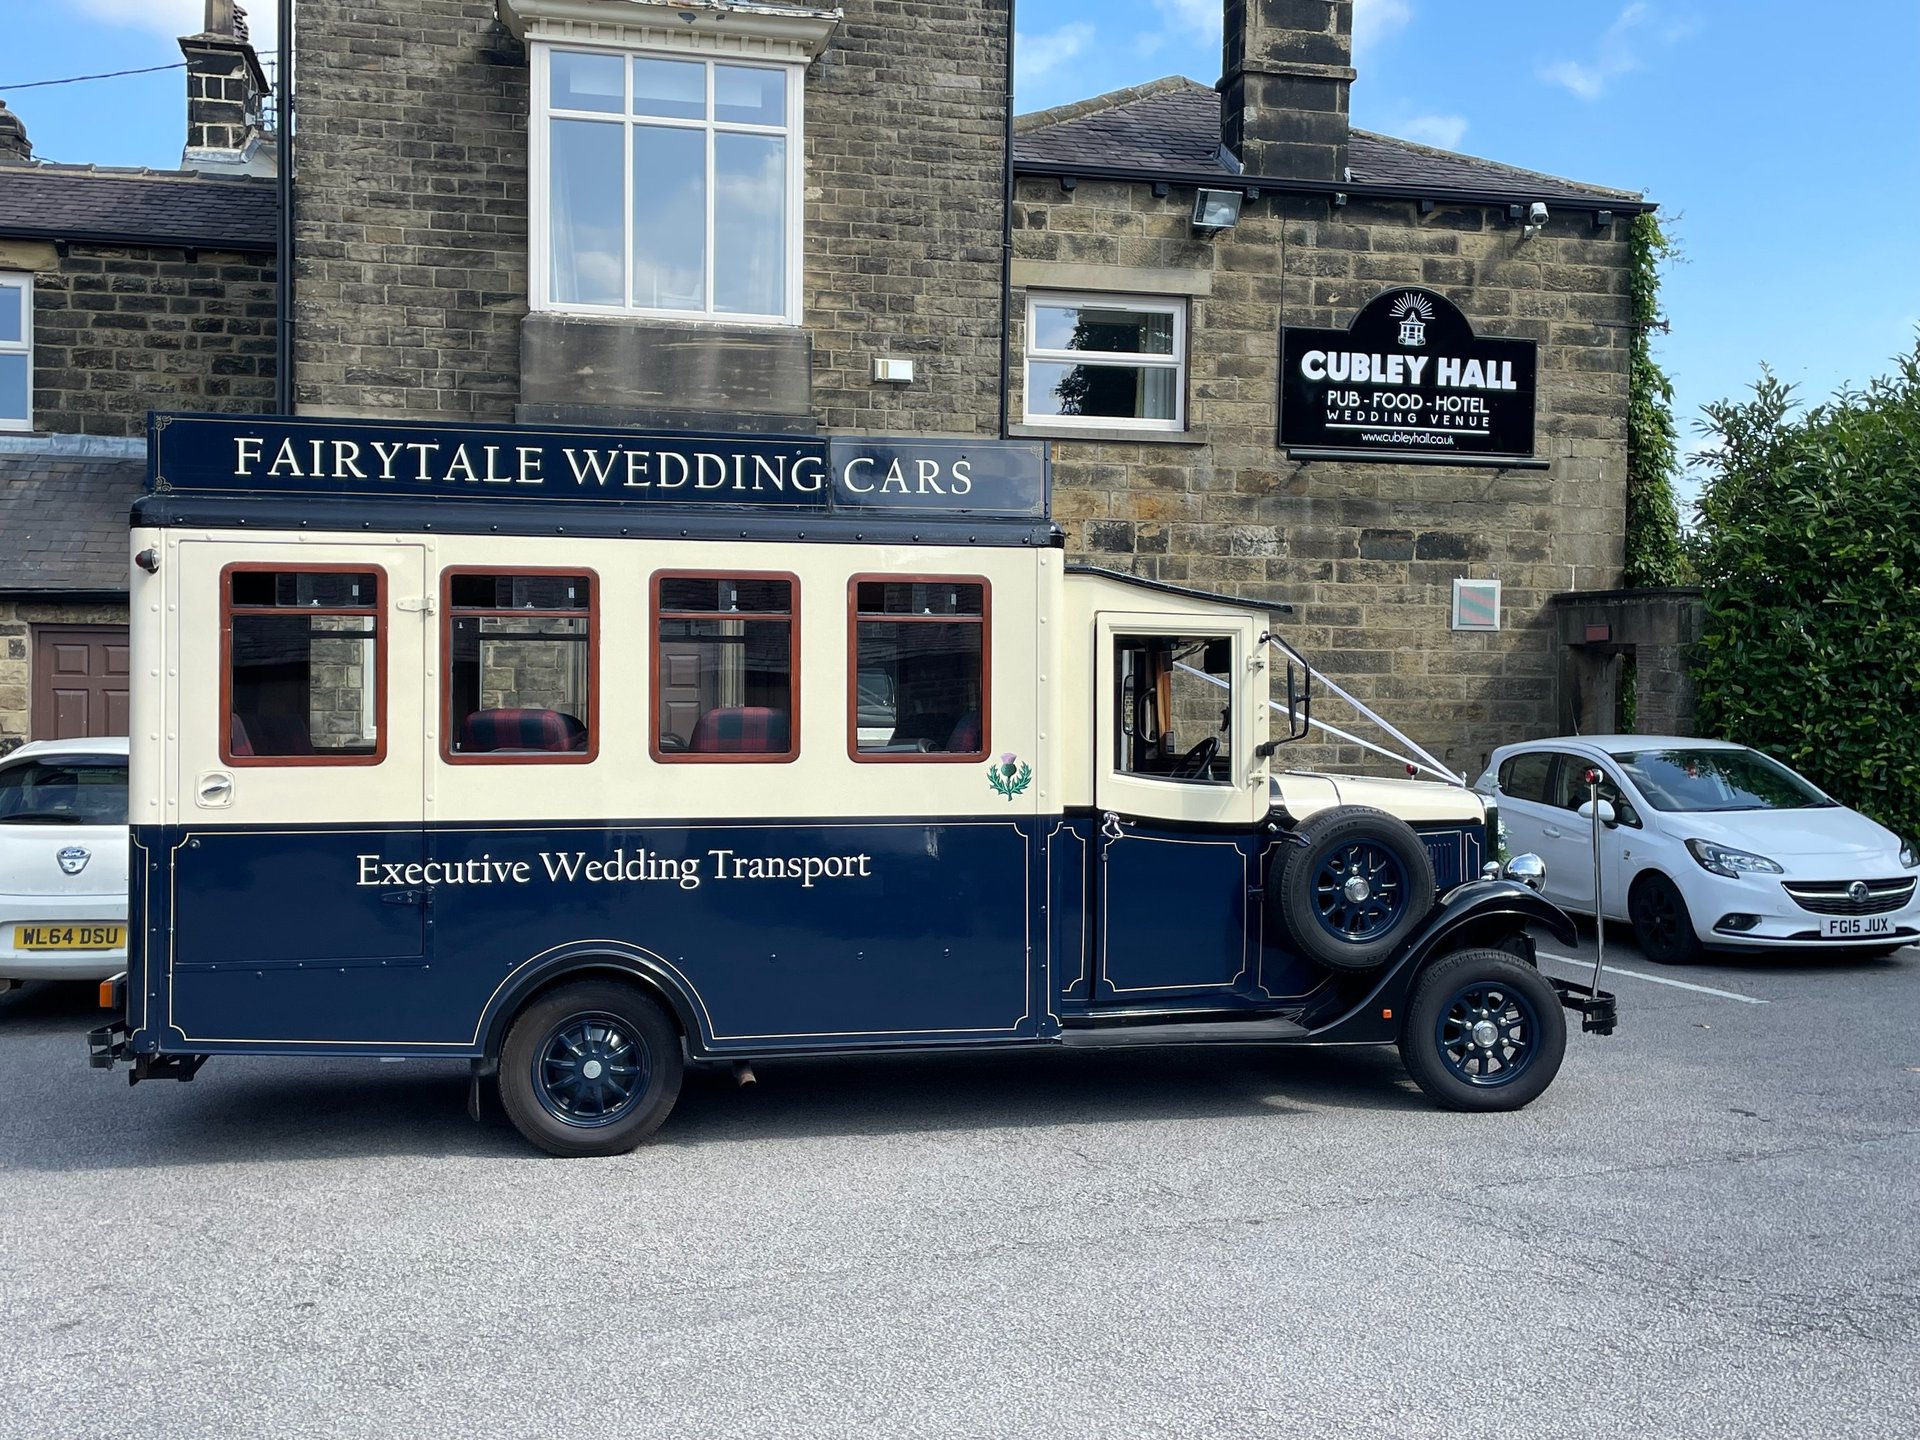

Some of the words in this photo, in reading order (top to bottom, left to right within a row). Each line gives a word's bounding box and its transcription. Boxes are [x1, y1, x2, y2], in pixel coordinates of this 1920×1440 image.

[1301, 350, 1429, 385] CUBLEY
[1437, 357, 1517, 390] HALL
[1326, 409, 1417, 424] WEDDING
[1430, 413, 1490, 427] VENUE
[1361, 431, 1454, 445] www.cubleyhall.co.uk
[234, 437, 545, 484] FAIRYTALE
[562, 448, 829, 492] WEDDING
[843, 457, 972, 495] CARS
[356, 853, 531, 886] Executive
[539, 848, 701, 889] Wedding
[707, 849, 872, 888] Transport
[1830, 920, 1861, 934] FG15
[1864, 918, 1889, 933] JUX
[23, 928, 74, 945] WL64
[79, 928, 118, 945] DSU
